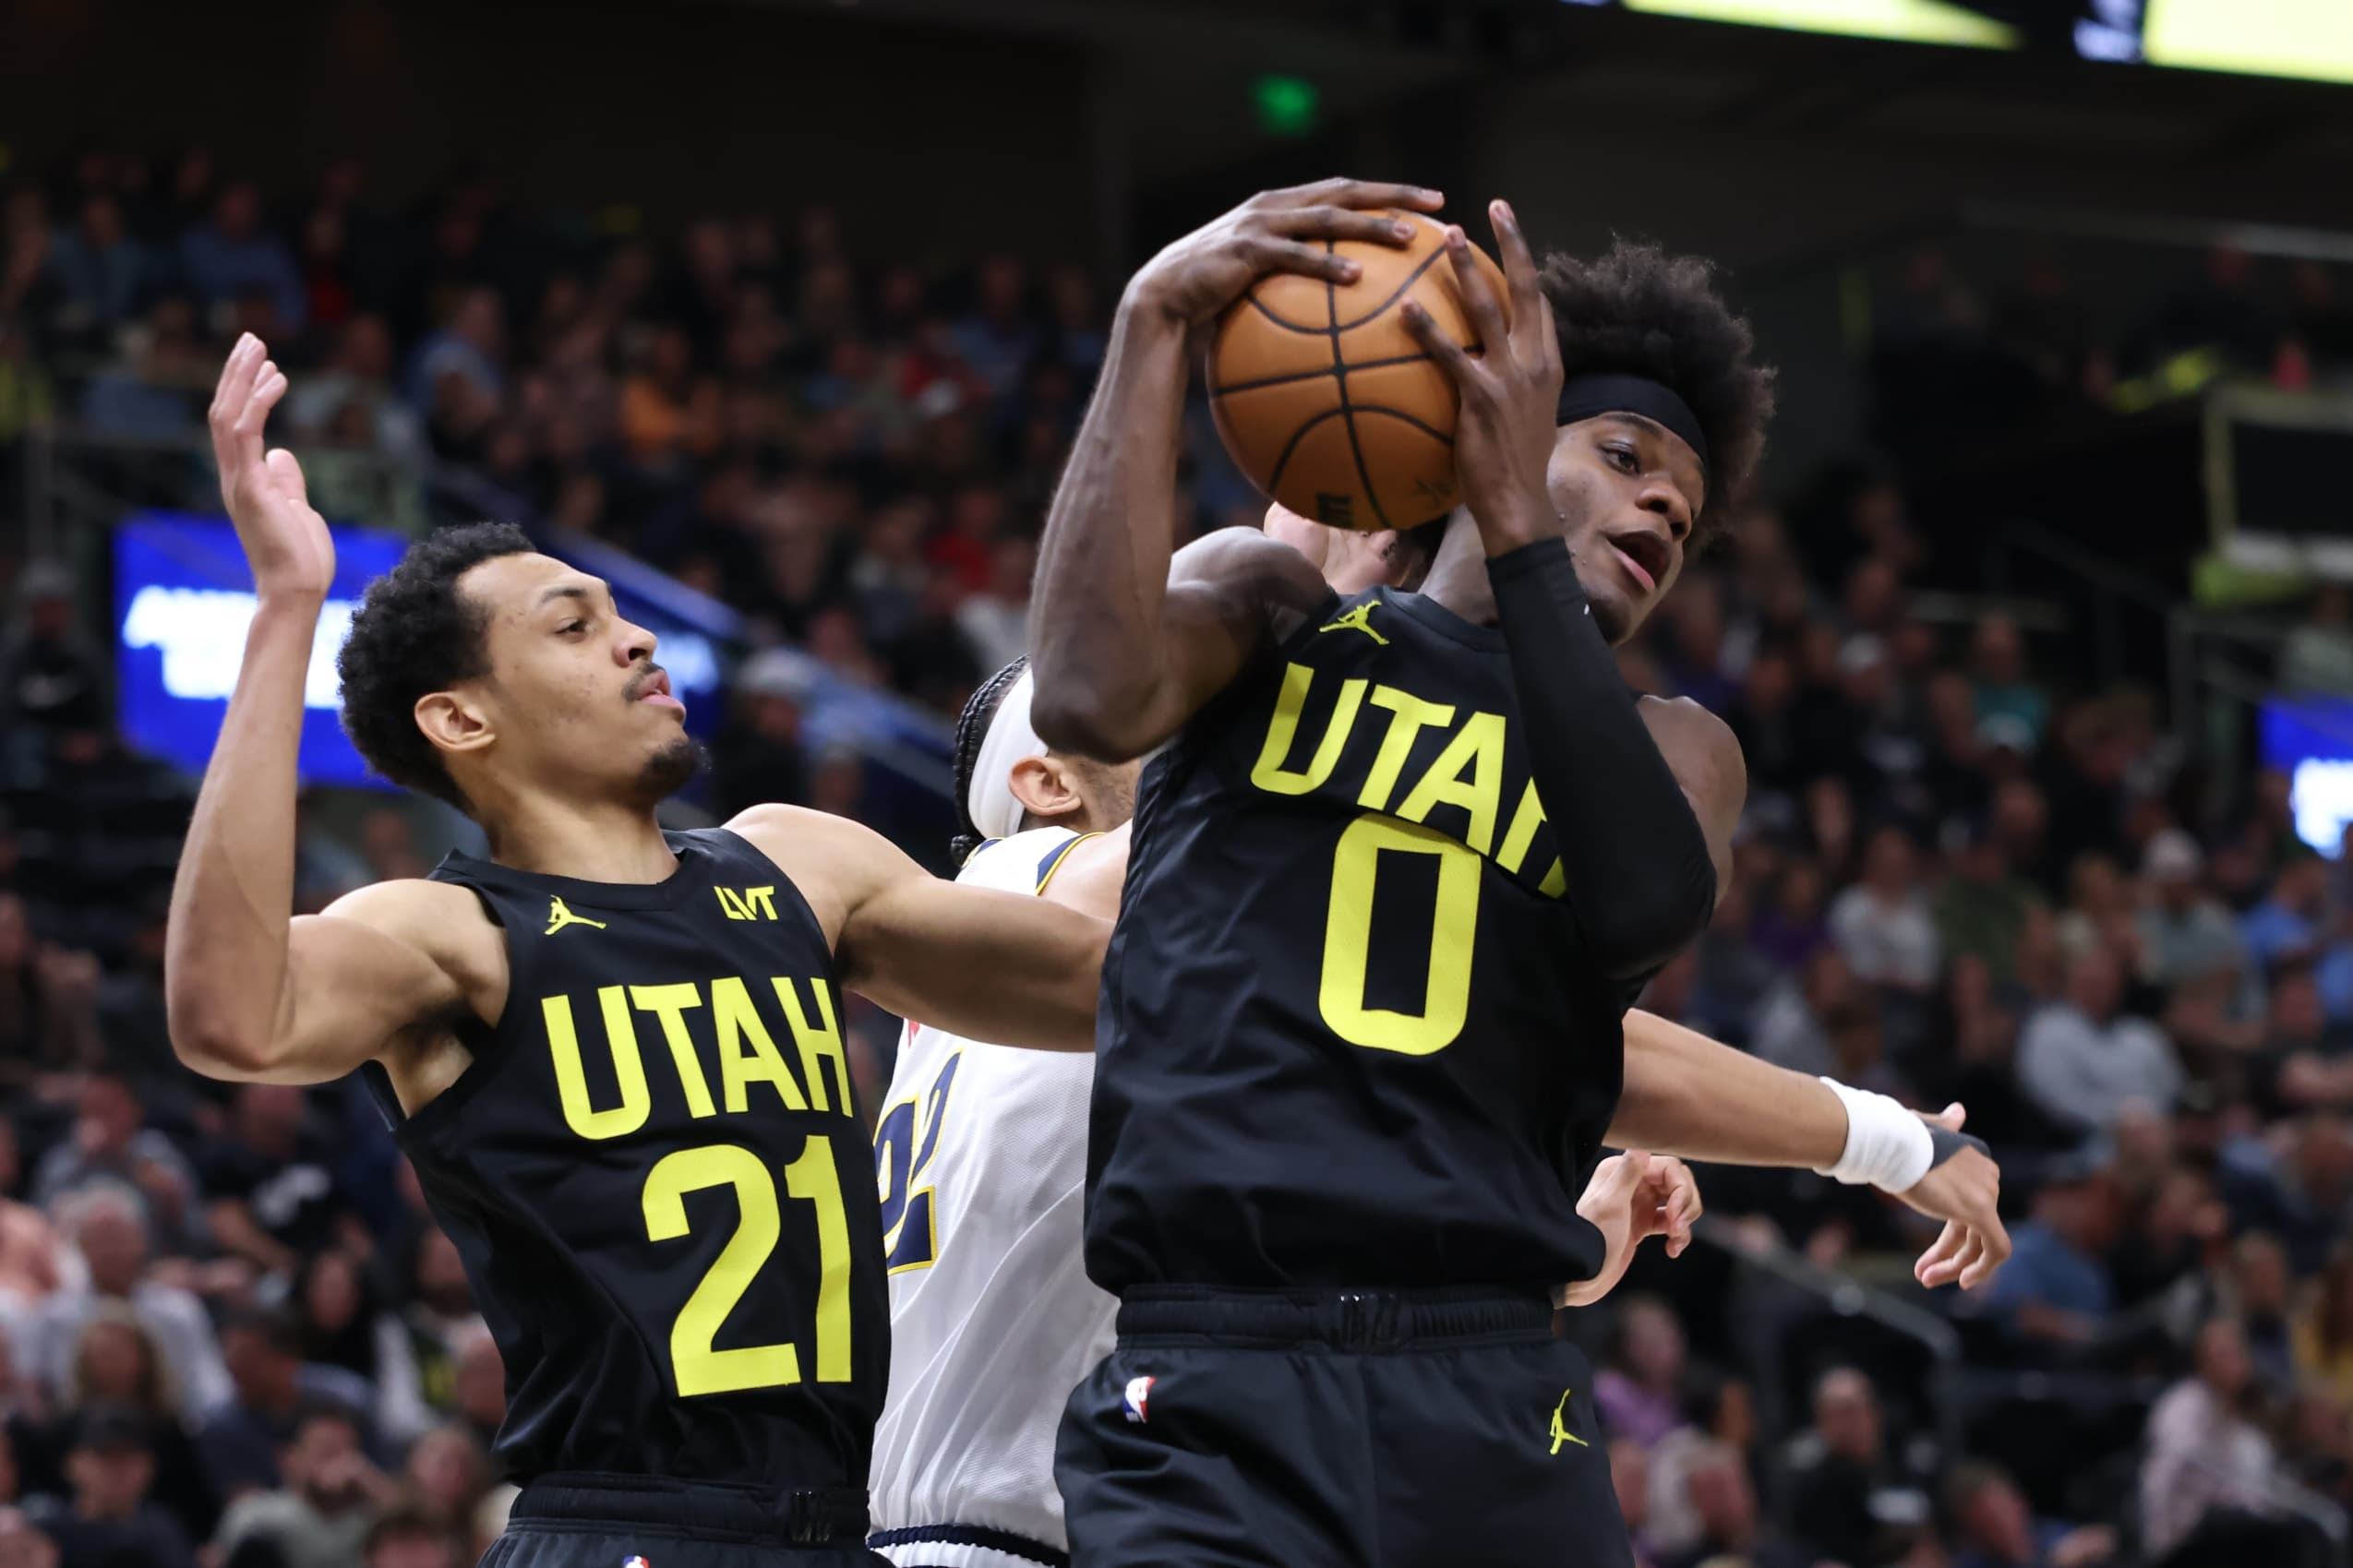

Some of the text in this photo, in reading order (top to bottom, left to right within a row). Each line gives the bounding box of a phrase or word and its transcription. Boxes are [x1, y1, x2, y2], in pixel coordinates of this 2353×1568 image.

[713, 885, 779, 921] LVT
[1317, 812, 1483, 1057] 0
[540, 976, 854, 1142] UTAH
[641, 1134, 853, 1399] 21
